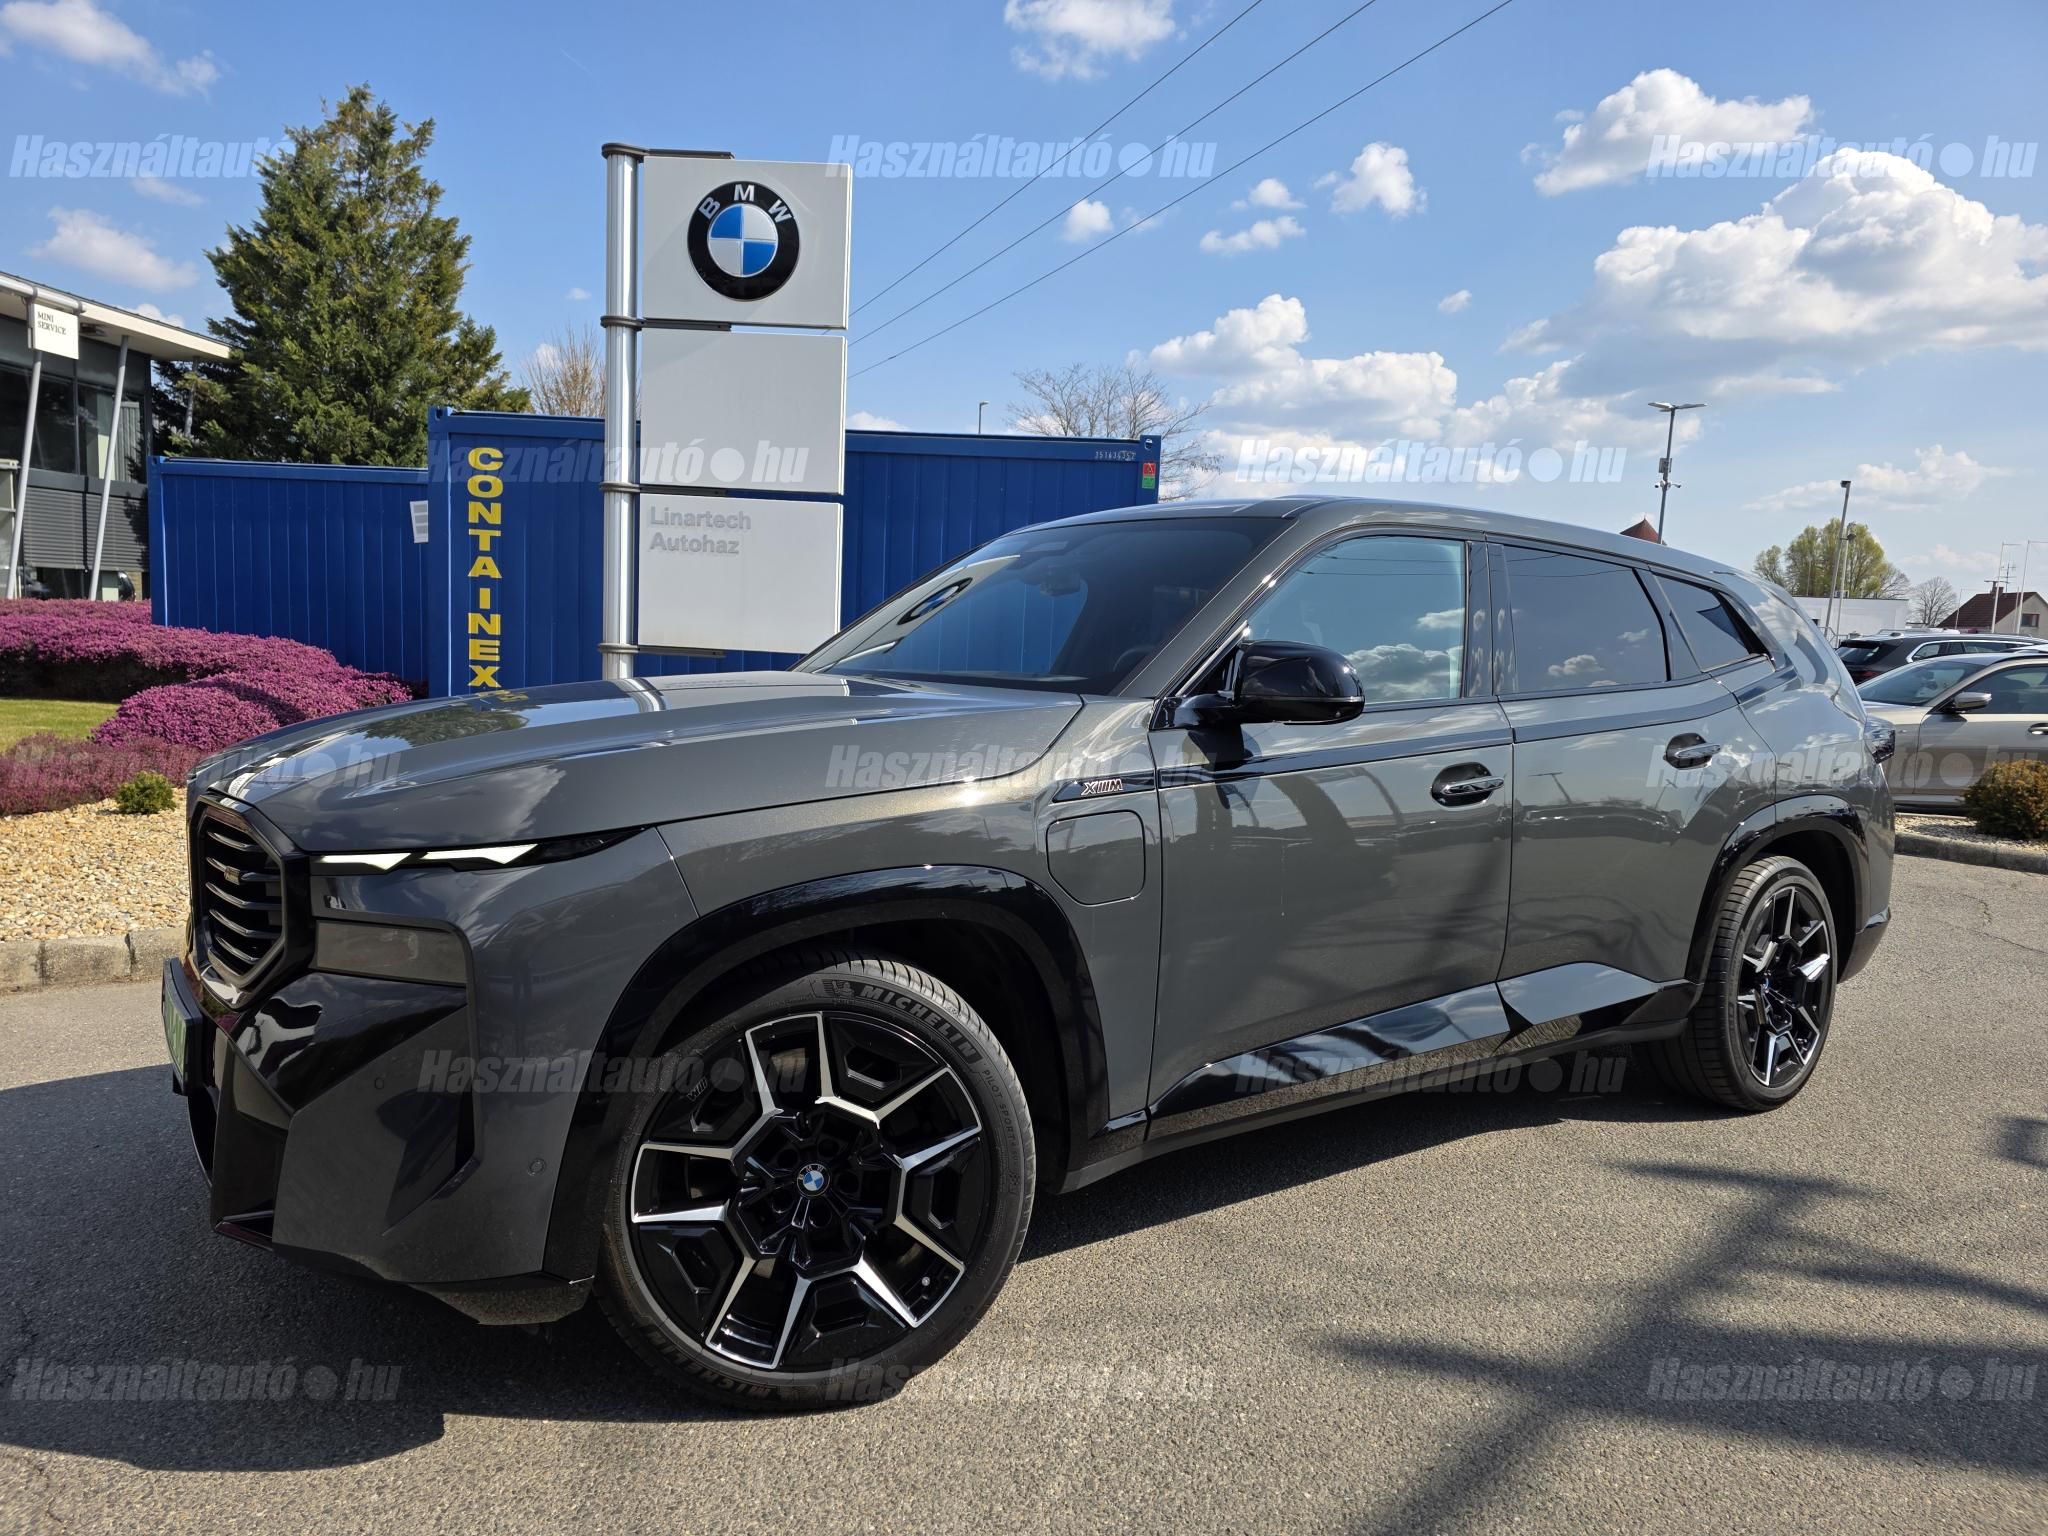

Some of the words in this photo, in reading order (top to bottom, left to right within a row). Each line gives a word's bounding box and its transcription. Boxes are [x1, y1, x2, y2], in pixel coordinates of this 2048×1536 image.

[698, 184, 792, 223] BMW
[37, 311, 54, 322] MINI
[38, 321, 67, 335] SERVICE
[650, 506, 752, 530] Linartech
[649, 532, 740, 554] Autohaz
[467, 447, 504, 688] CONTAINEX
[859, 985, 977, 1058] MICHELIN
[984, 1069, 1003, 1098] PILOT
[1001, 1103, 1016, 1139] SPORT
